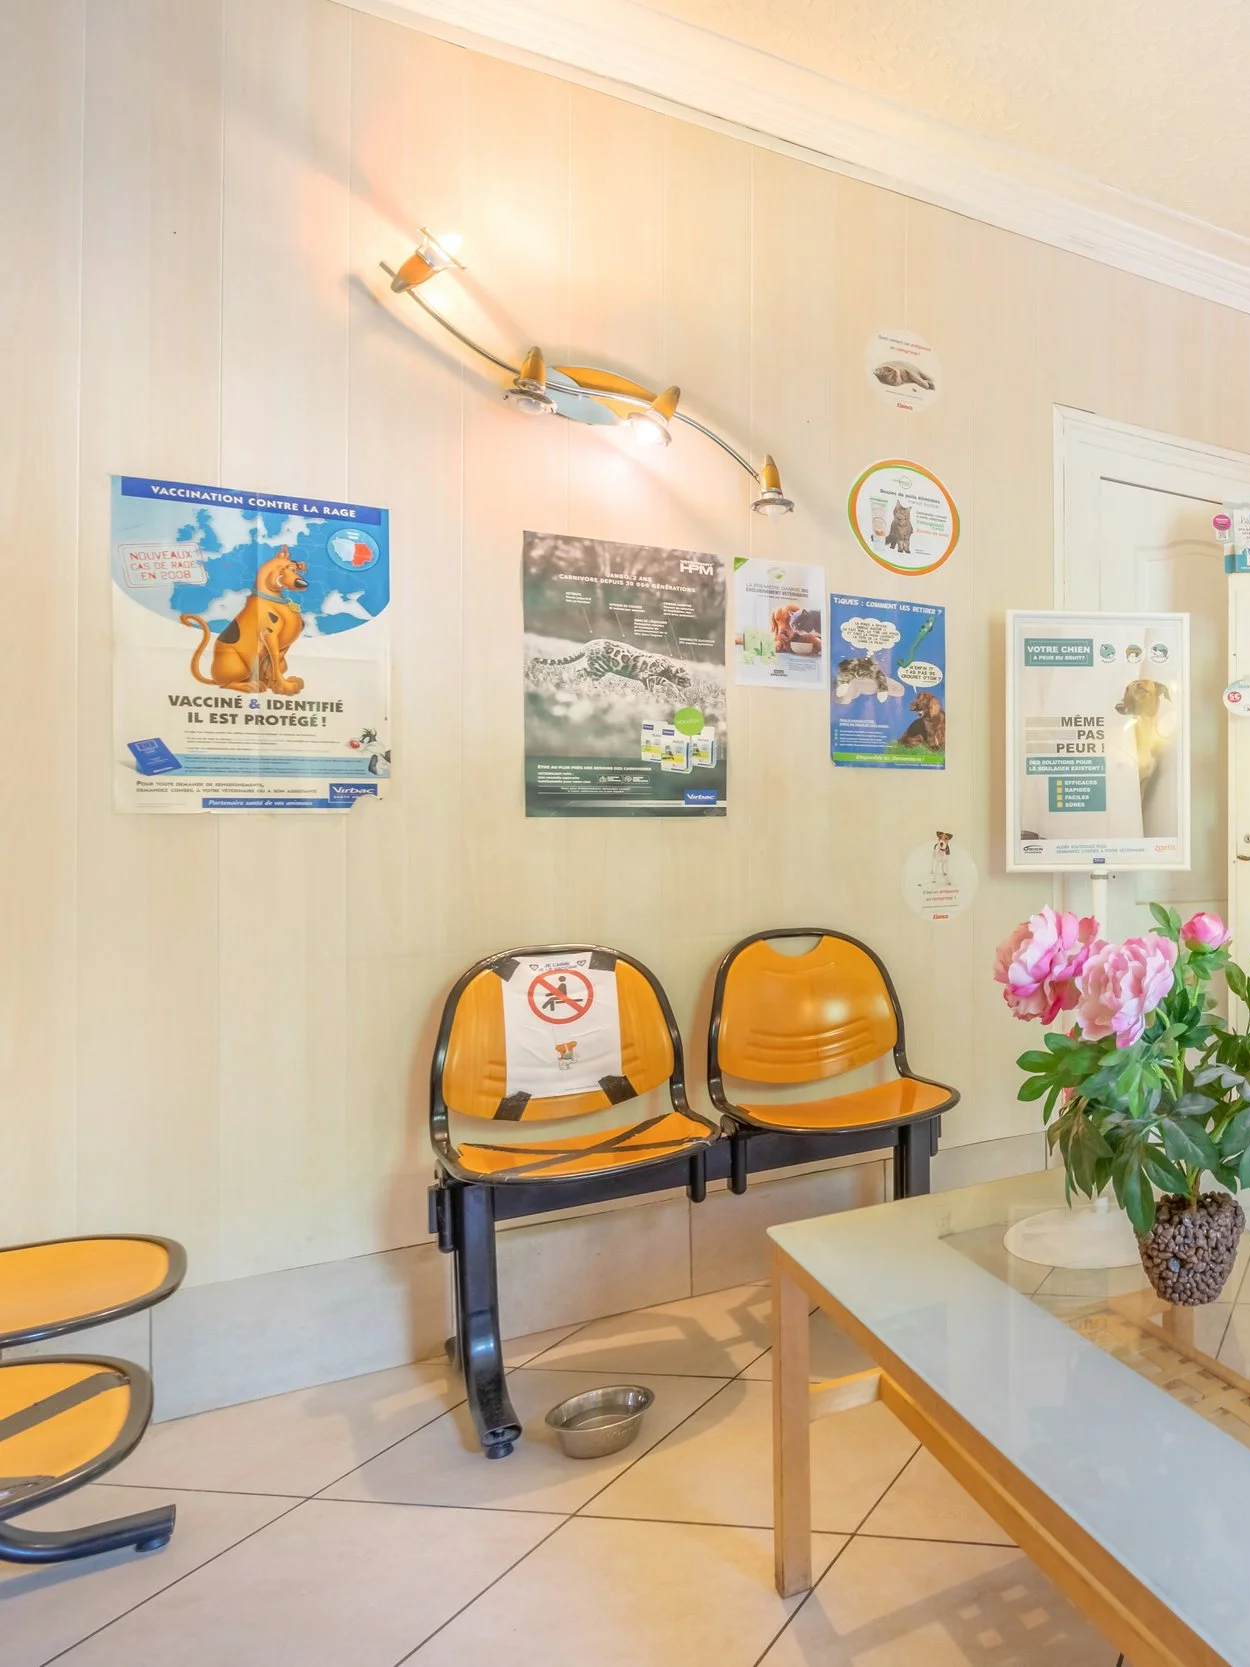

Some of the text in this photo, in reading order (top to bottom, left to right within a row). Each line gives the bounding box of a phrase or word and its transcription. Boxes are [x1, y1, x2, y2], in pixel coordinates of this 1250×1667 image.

[880, 488, 897, 496] Boules
[151, 485, 356, 518] VACCINATION CONTRE LA RAGE
[130, 550, 192, 561] NOUVEAUX
[130, 560, 196, 570] CAS DE RAGE
[680, 564, 714, 576] HPM
[141, 570, 191, 580] EN 2008
[559, 574, 598, 583] CARNIVORE
[600, 578, 624, 586] DEPUIS
[652, 583, 696, 593] GÉNÉRATIONS
[834, 597, 859, 606] TIQUES
[866, 601, 897, 610] COMMENT
[913, 606, 936, 615] RETIRER
[1027, 646, 1058, 654] VOTRE
[168, 694, 344, 713] VACCINÉ & IDENTIFIÉ
[187, 712, 326, 727] IL EST PROTÉGÉ !
[1061, 714, 1104, 727] MÊME
[1077, 730, 1104, 740] PAS
[1056, 743, 1097, 753] PEUR
[332, 786, 375, 794] Virbac
[1154, 844, 1176, 853] zoetis
